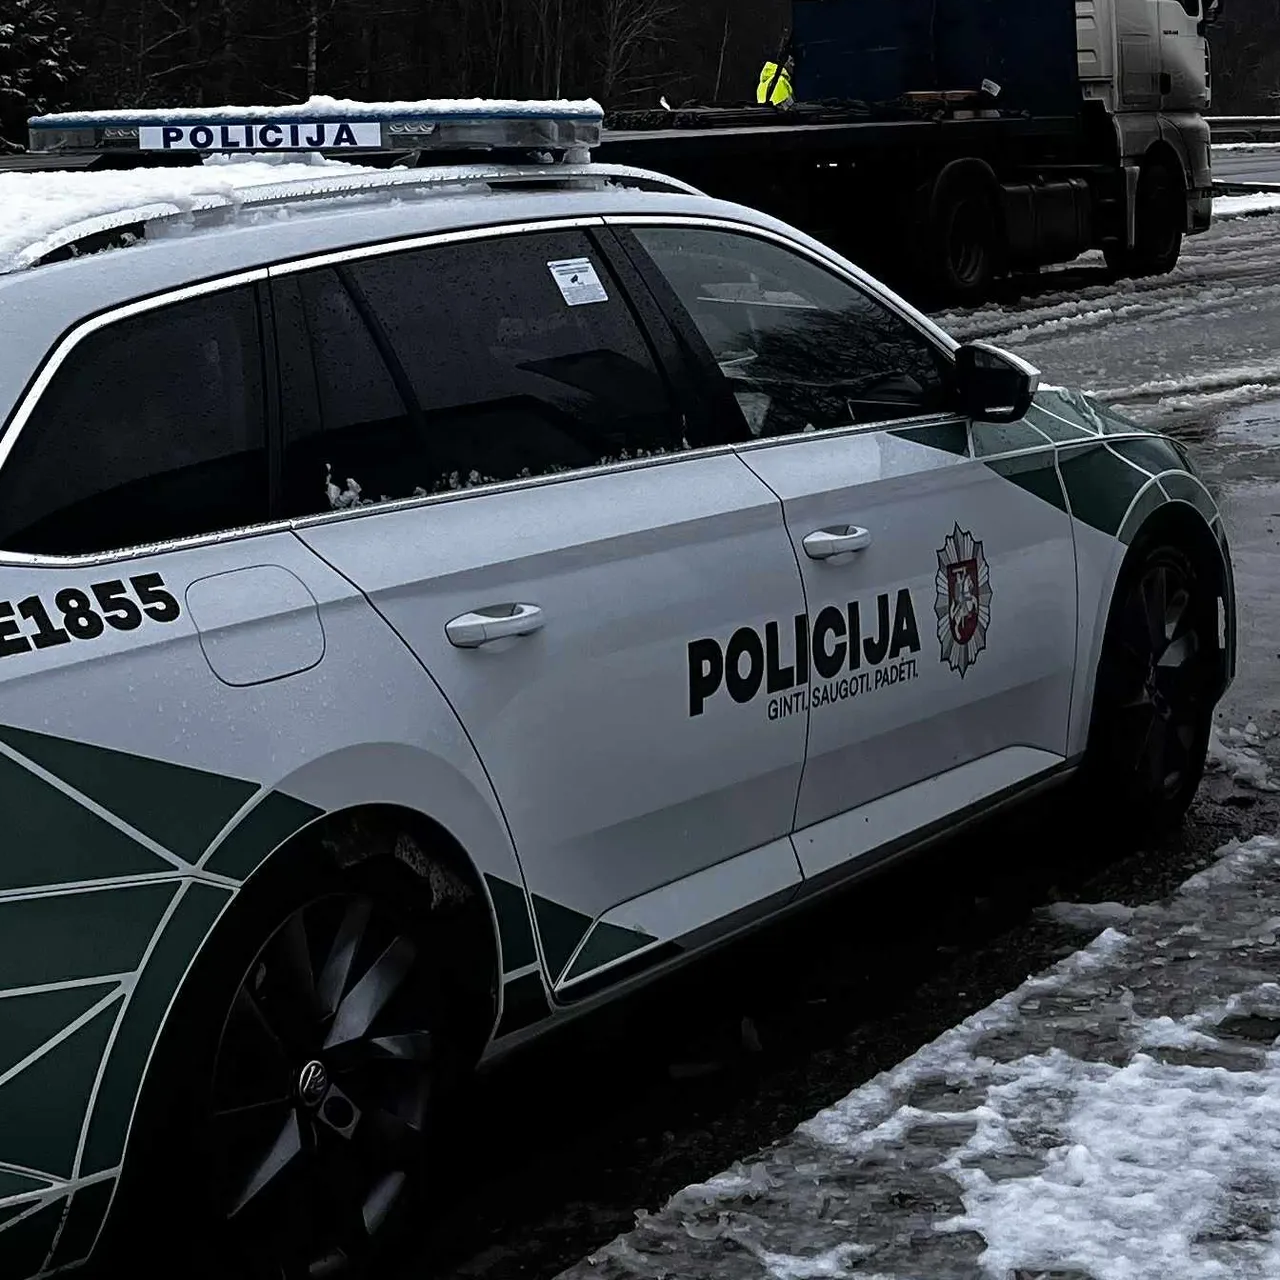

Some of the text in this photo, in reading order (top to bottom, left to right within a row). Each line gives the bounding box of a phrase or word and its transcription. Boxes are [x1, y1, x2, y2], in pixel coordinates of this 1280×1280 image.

[162, 123, 358, 149] POLICIJA
[687, 588, 922, 718] POLICIJA
[767, 657, 919, 721] GINTI. SAUGOTI. PADĖTI.
